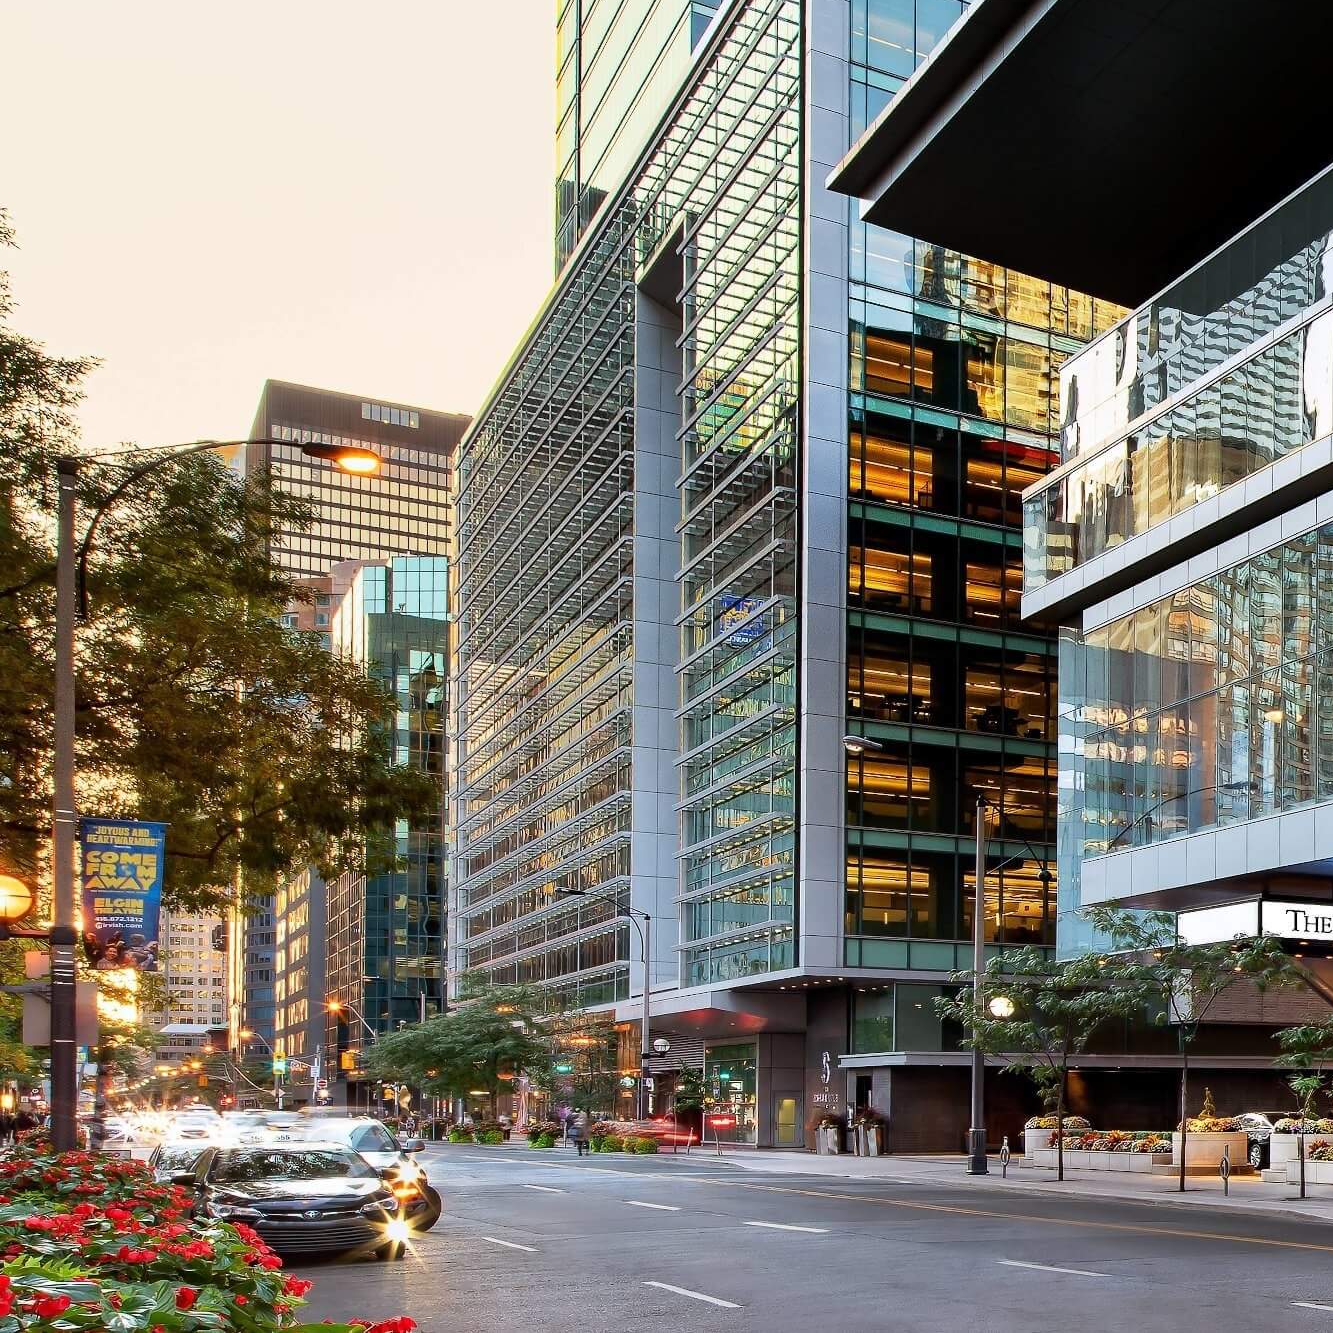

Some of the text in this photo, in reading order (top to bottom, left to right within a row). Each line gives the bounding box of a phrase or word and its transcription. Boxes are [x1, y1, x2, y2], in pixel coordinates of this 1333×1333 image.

[132, 828, 150, 838] AND
[86, 851, 157, 866] COME
[84, 876, 157, 891] AWAY
[94, 897, 144, 908] ELGIN
[1286, 909, 1332, 934] THE
